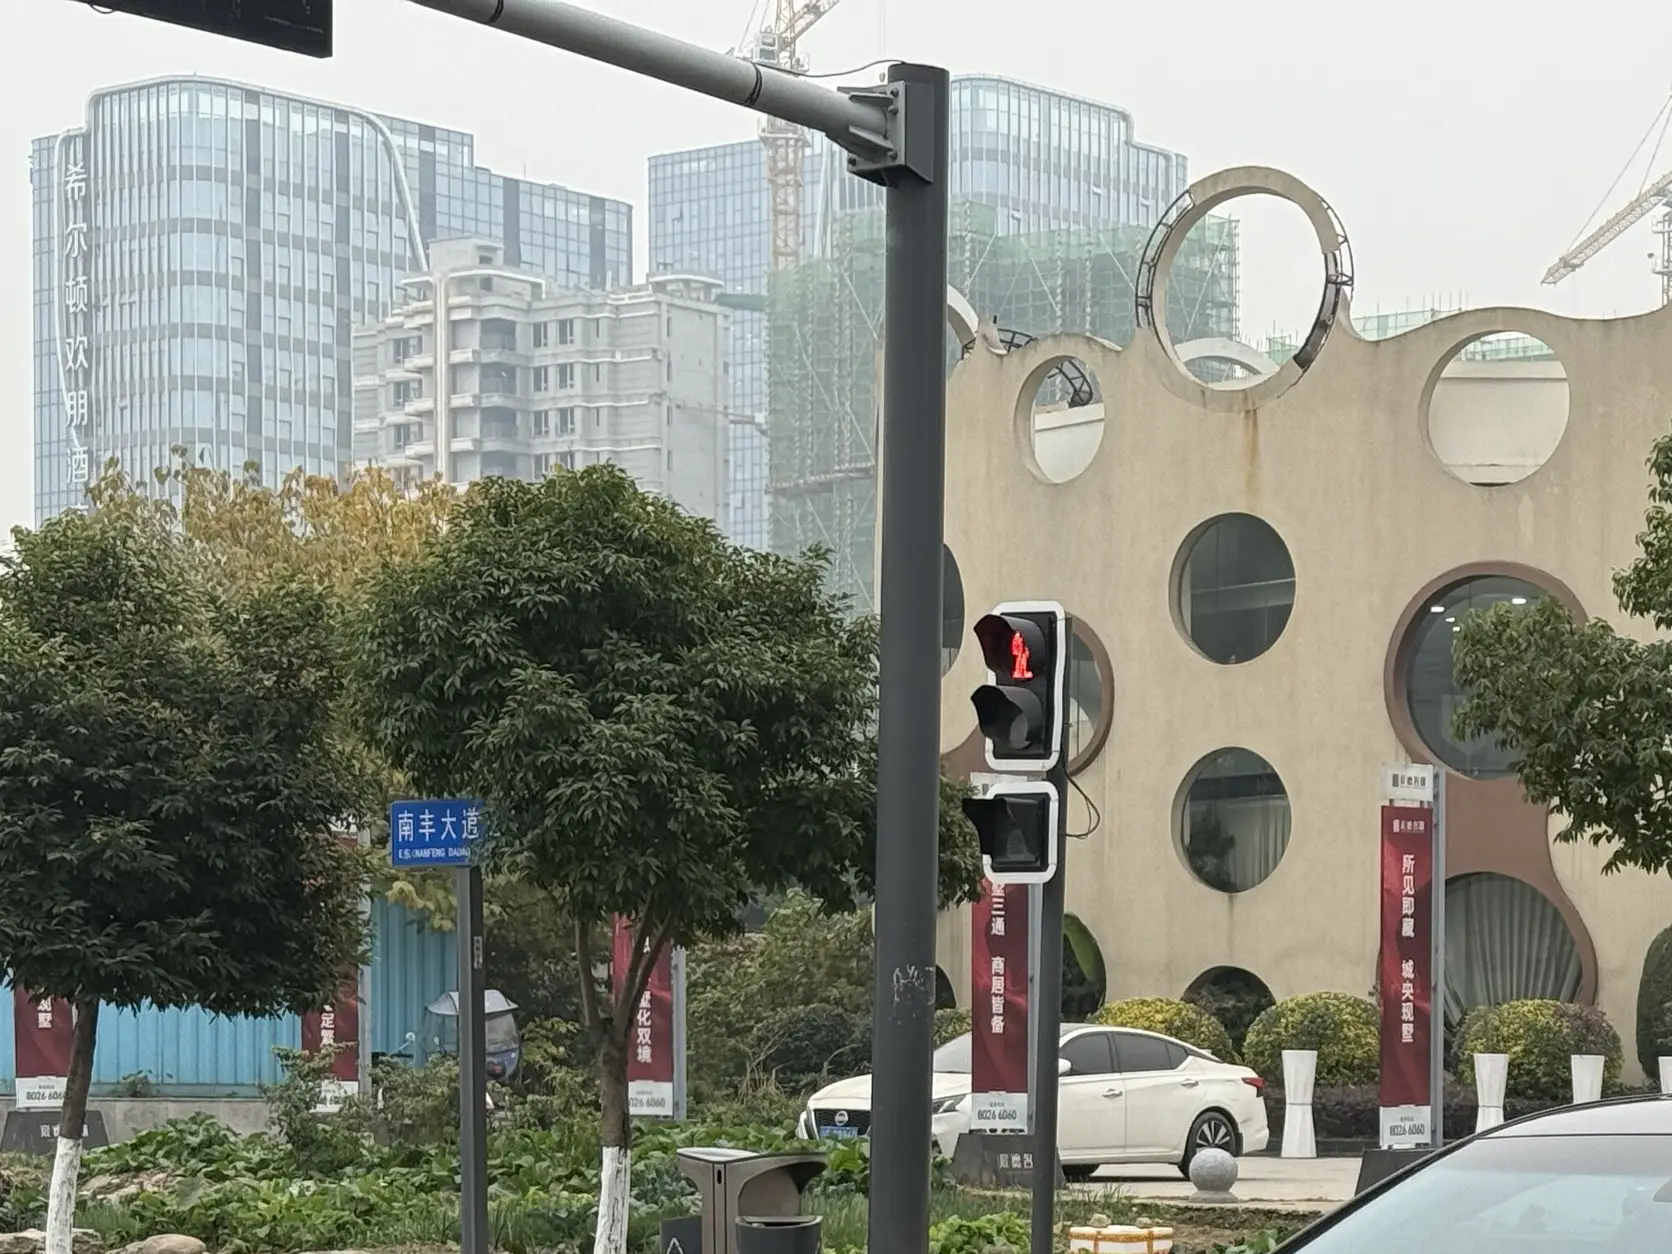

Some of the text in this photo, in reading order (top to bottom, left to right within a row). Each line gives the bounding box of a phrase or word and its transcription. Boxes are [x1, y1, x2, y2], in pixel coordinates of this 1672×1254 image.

[64, 161, 89, 516] 希尔顿欢朋酒
[398, 807, 480, 842] 南丰大道
[48, 1090, 67, 1100] 606
[629, 1097, 644, 1108] 026
[977, 1109, 1017, 1121] 8026 6060
